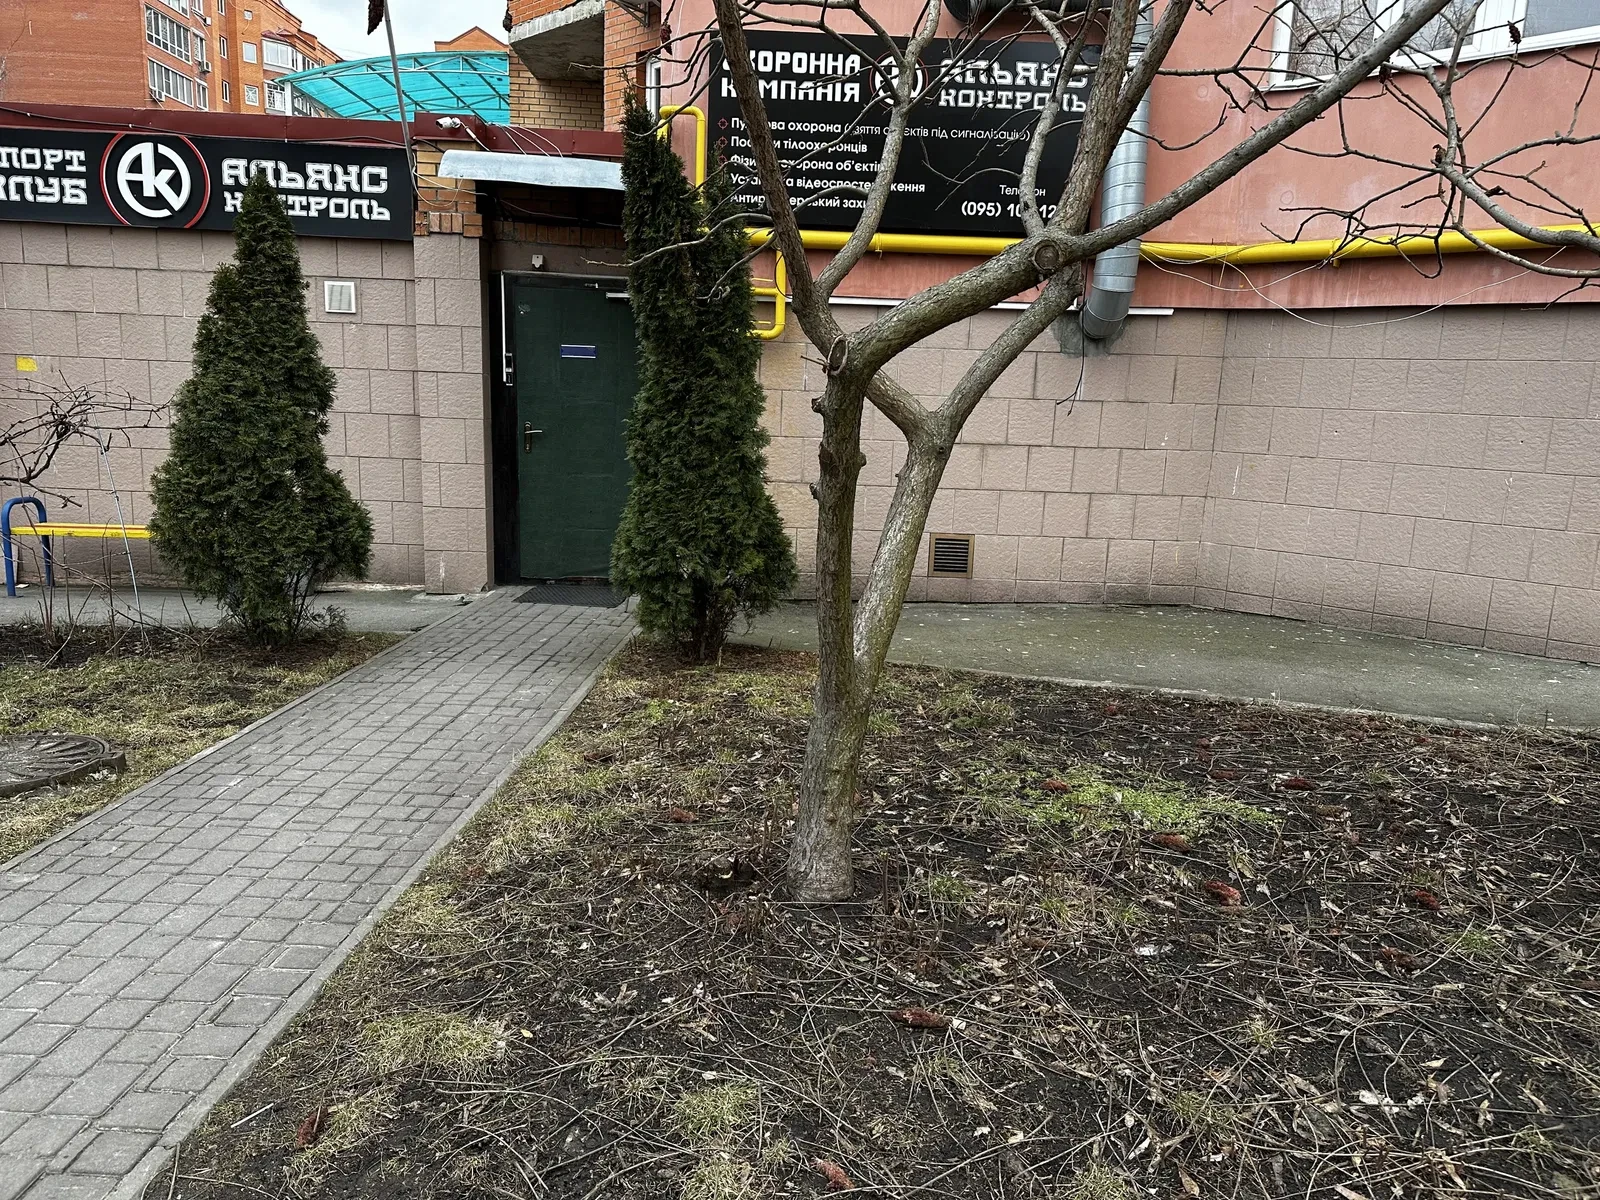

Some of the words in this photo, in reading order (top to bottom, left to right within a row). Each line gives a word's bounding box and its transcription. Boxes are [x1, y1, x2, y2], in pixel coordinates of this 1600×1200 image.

[722, 50, 861, 75] ОРОННА
[721, 77, 860, 102] КМПАНІЯ
[731, 117, 786, 131] Пува
[788, 121, 841, 134] охорона
[844, 123, 881, 136] (зяття
[883, 126, 929, 138] оєктів
[931, 126, 949, 139] під
[950, 128, 1031, 142] сигналізацію)
[730, 136, 781, 149] Поси
[783, 138, 868, 154] тілоохоронців
[0, 146, 87, 172] ПОРТ
[221, 157, 388, 194] АЛЬЯНС
[730, 194, 840, 208] Антирерький
[999, 184, 1046, 197] Телон
[223, 191, 391, 221] КТРОЛЬ
[961, 200, 1002, 217] (095)
[1006, 203, 1022, 218] 10
